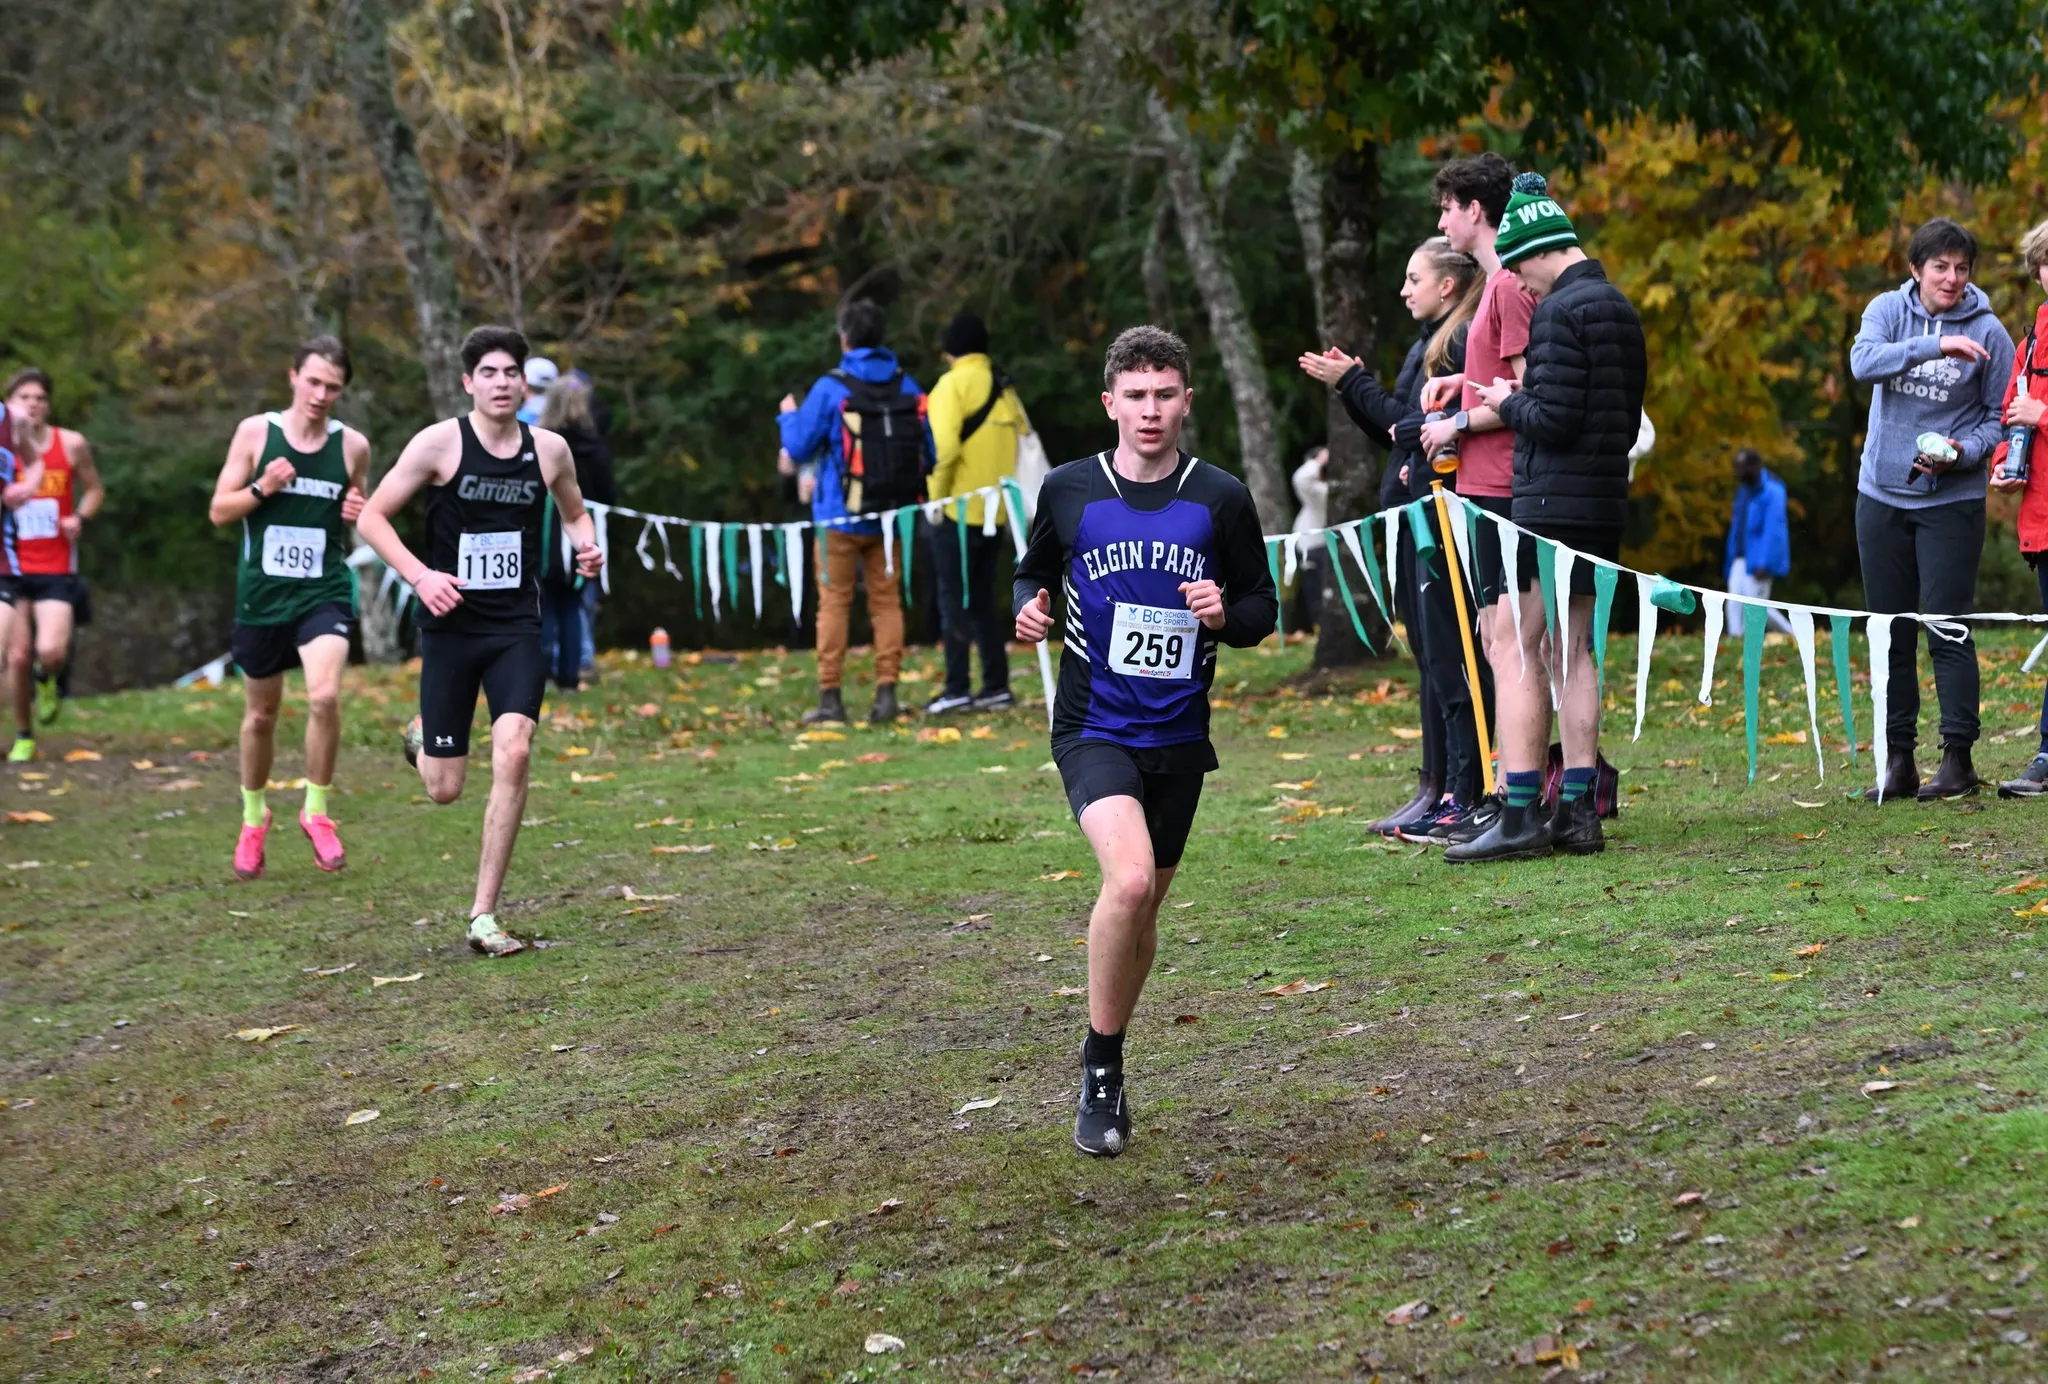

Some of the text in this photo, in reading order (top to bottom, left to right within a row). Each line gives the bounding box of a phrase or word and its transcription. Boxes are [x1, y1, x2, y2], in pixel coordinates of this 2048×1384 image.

[1517, 200, 1566, 225] WOL
[1889, 376, 1949, 402] Roots
[274, 545, 313, 570] 498
[465, 552, 518, 580] 1138
[1082, 541, 1206, 581] ELGIN PARK
[1142, 609, 1162, 624] BC
[1163, 618, 1188, 626] SPORTS
[1164, 611, 1188, 619] SCHOOL
[1123, 631, 1183, 669] 259
